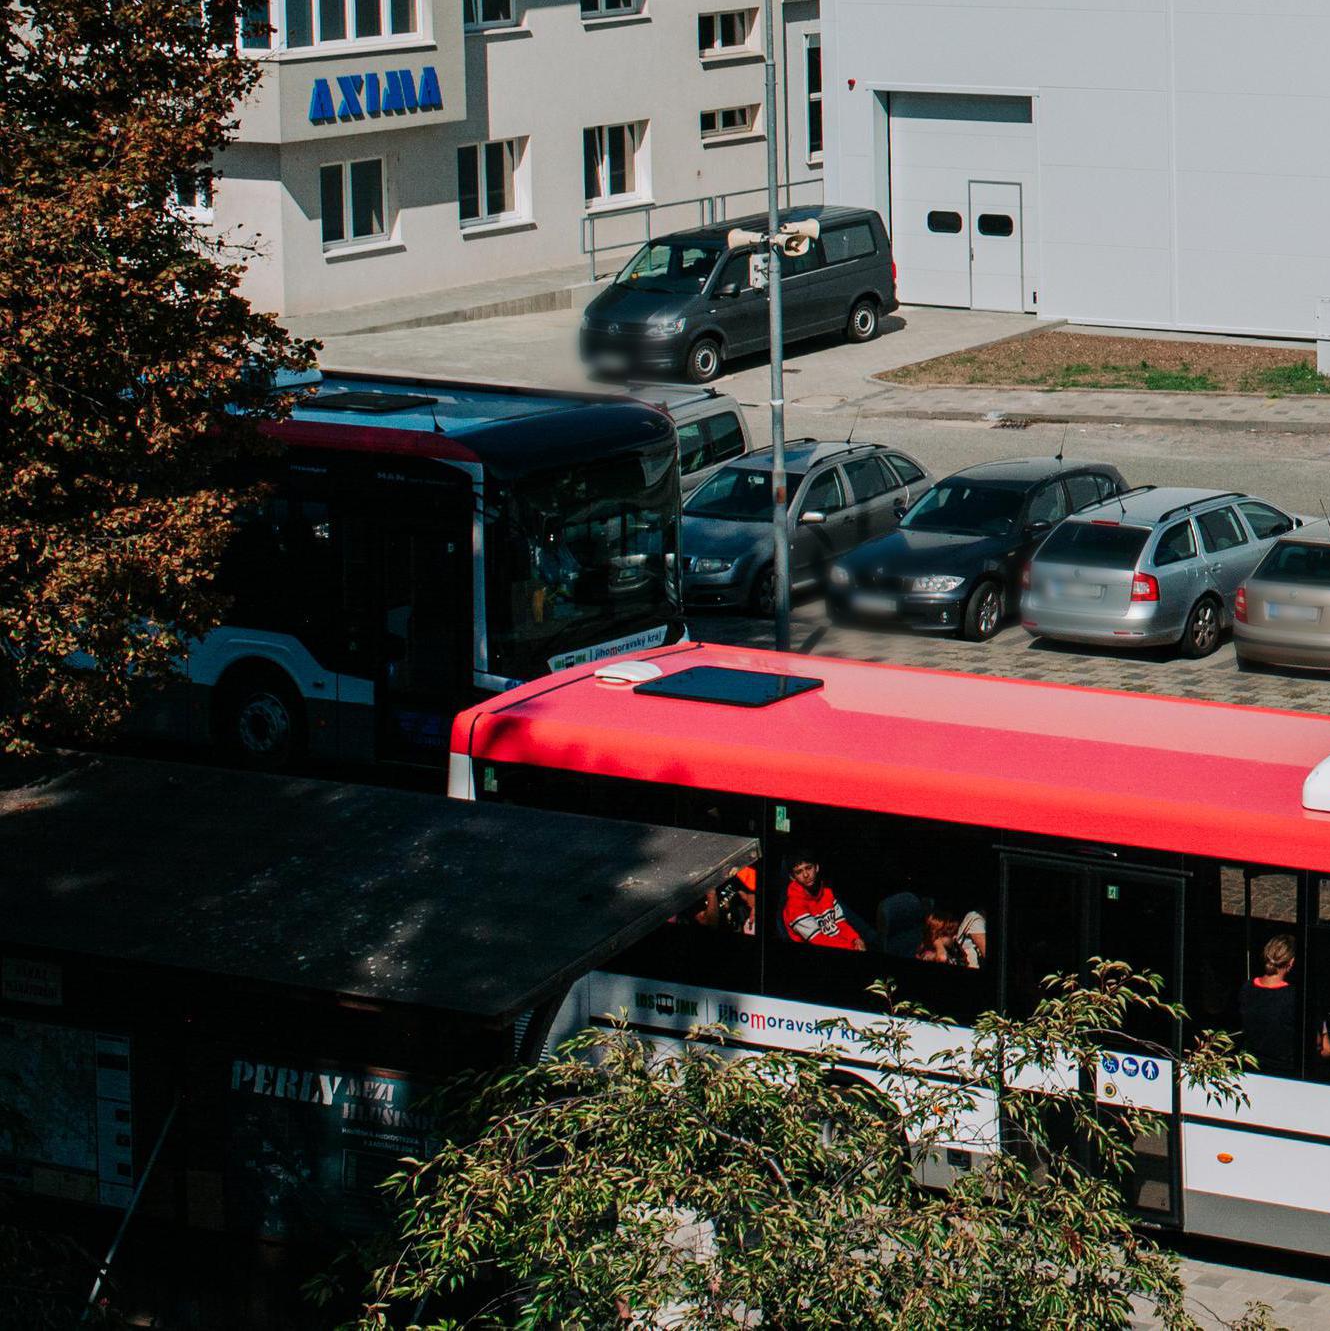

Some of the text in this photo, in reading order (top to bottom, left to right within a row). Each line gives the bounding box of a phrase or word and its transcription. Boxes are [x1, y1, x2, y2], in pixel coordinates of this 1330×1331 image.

[309, 66, 443, 124] AXIMA
[595, 631, 662, 660] jihomoravský kraj
[231, 1060, 343, 1106] PERLY
